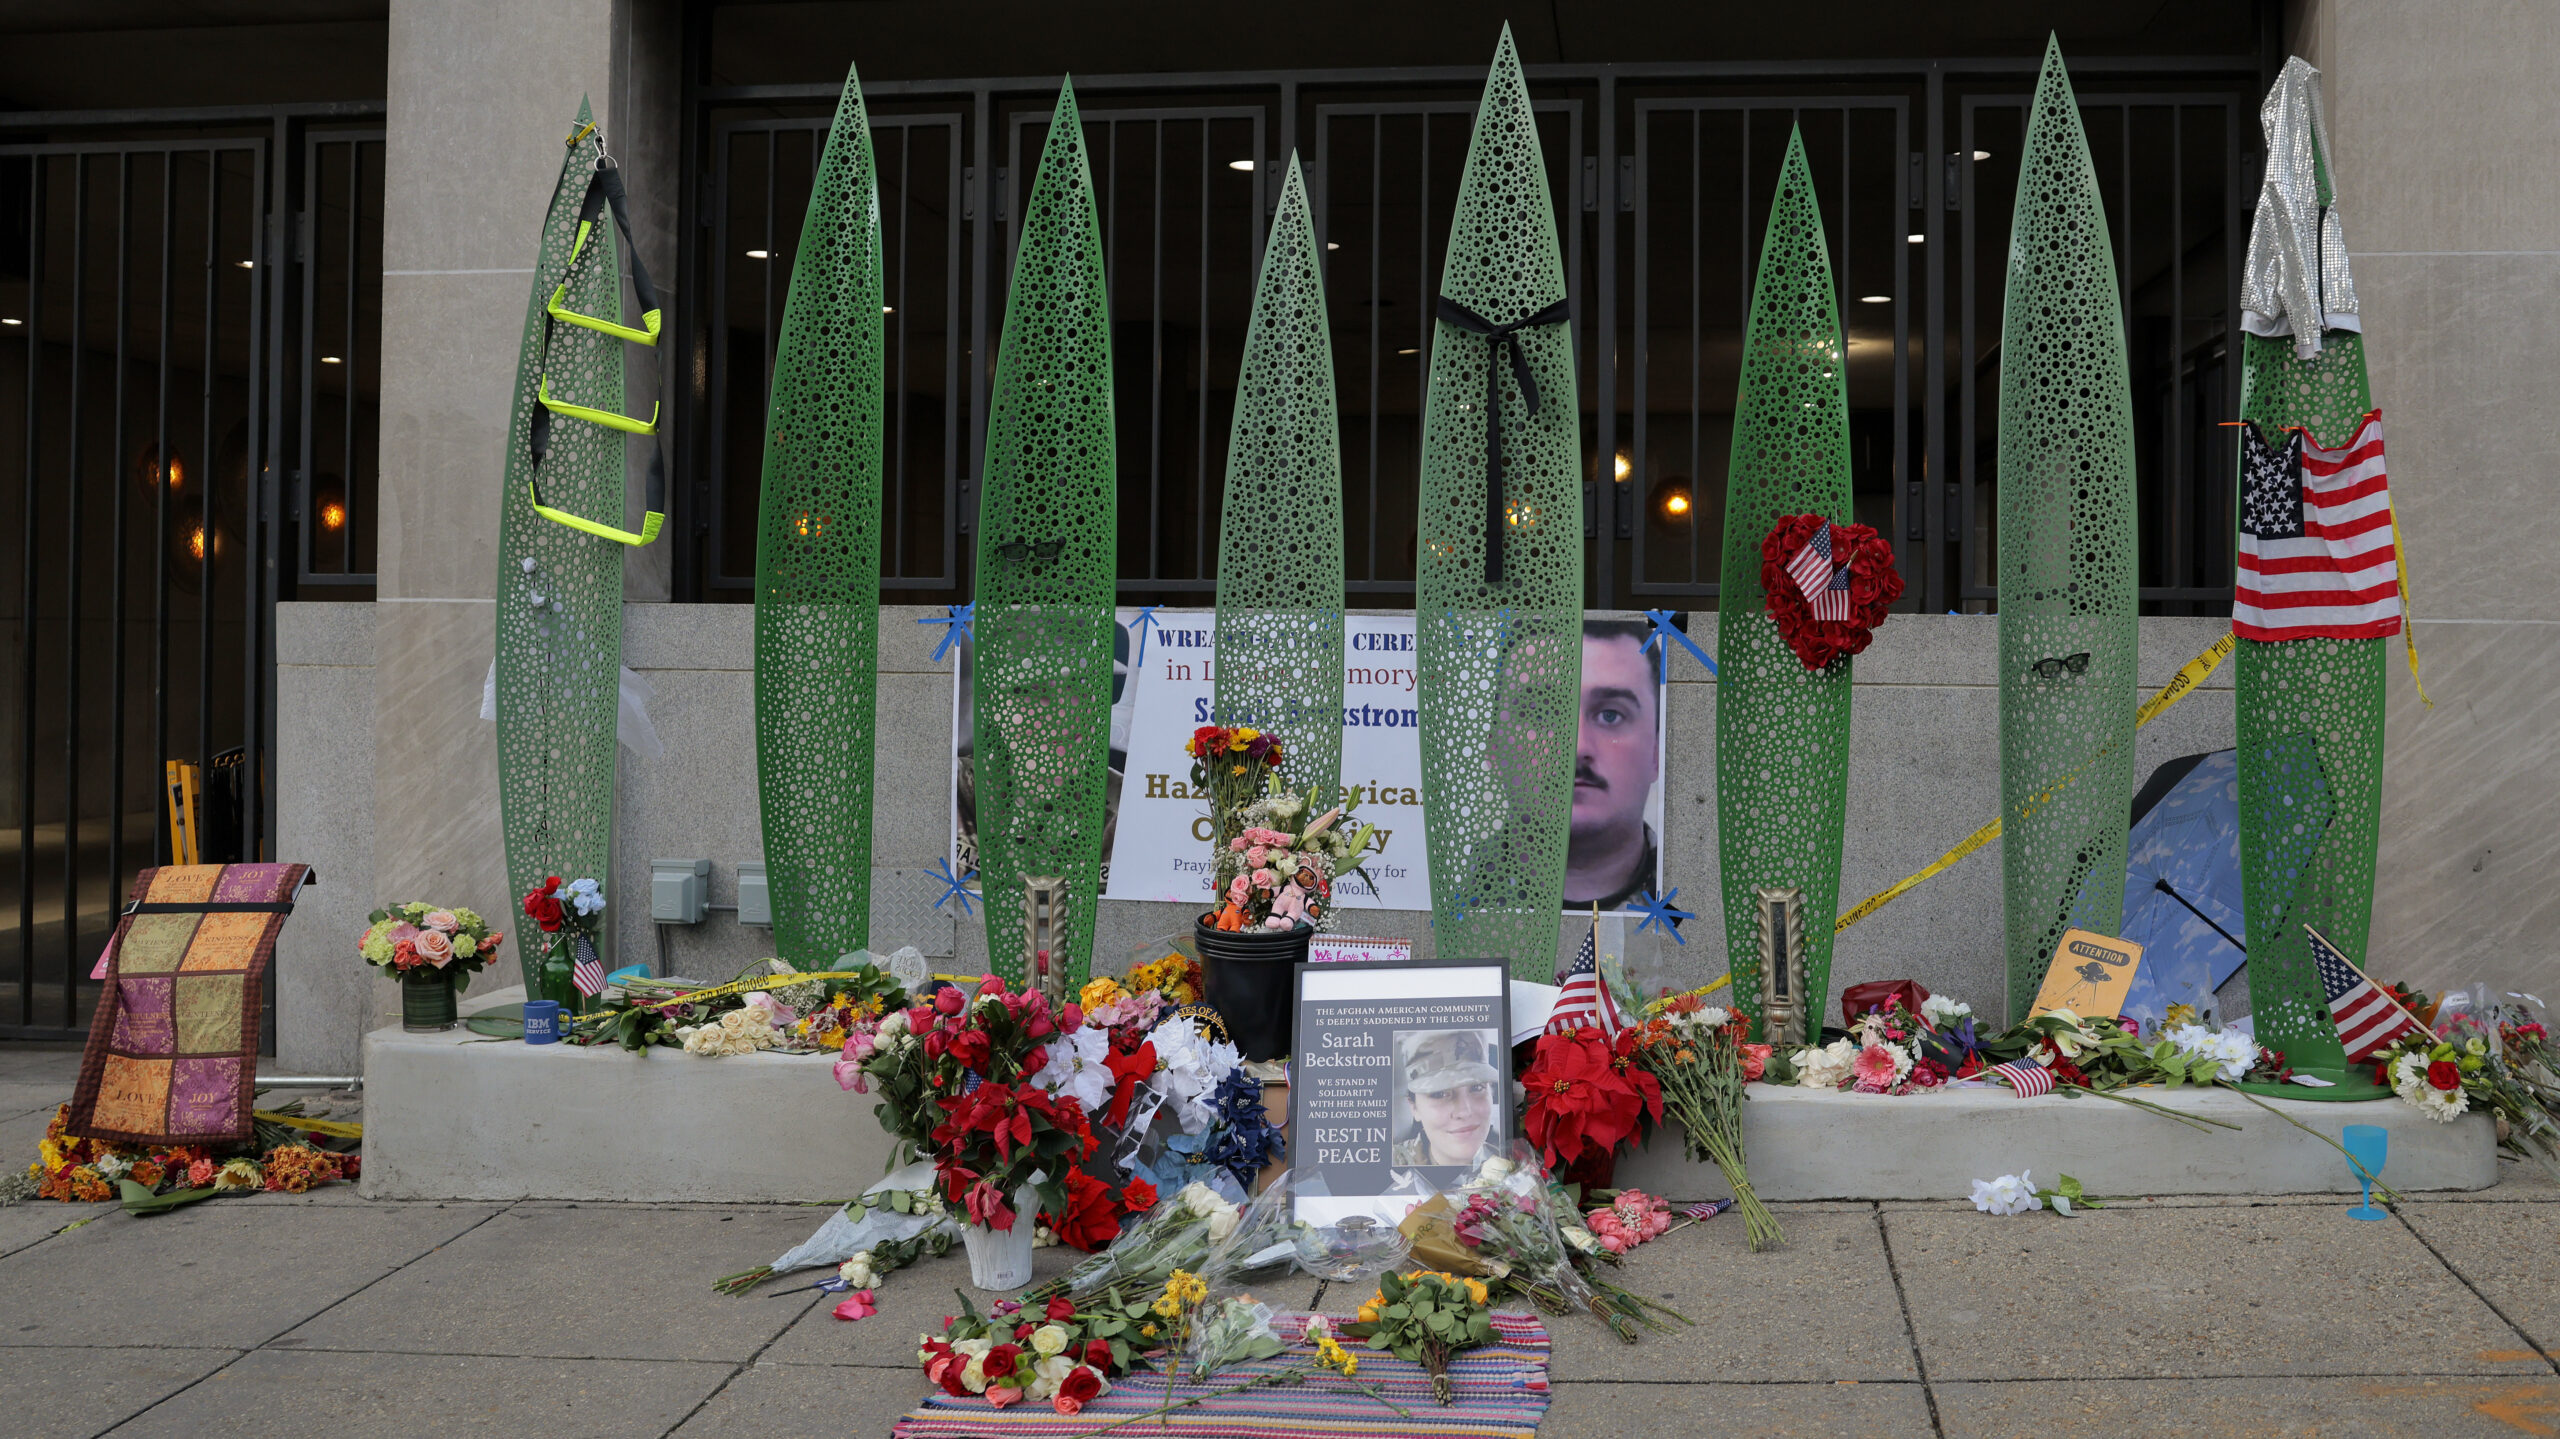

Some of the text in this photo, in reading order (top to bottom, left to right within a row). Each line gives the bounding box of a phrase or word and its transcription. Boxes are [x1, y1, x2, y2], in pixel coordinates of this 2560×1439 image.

[1353, 632, 1417, 651] CERE
[1166, 658, 1192, 681] in
[1346, 668, 1418, 692] mory
[1145, 773, 1208, 800] Haz
[1173, 858, 1213, 875] Prayi
[1385, 864, 1407, 878] for
[166, 874, 204, 883] LOVE
[239, 870, 268, 880] JOY
[1314, 949, 1333, 961] We
[1336, 950, 1359, 961] Love
[2072, 942, 2124, 964] ATTENTION
[1316, 1004, 1490, 1016] THE AFGHAN AMERICAN COMMUNITY
[527, 1018, 550, 1028] IBM
[1316, 1014, 1490, 1026] IS DEEPLY SADDENED BY THE LOSS OF
[1322, 1032, 1375, 1048] Sarah
[1305, 1052, 1392, 1068] Beckstrom
[1317, 1078, 1377, 1086] WE STAND IN
[116, 1090, 155, 1104] LOVE
[188, 1092, 217, 1104] JOY
[1318, 1089, 1374, 1097] SOLIDARITY
[1336, 1099, 1354, 1107] HER
[1356, 1099, 1388, 1108] FAMILY
[1308, 1110, 1387, 1119] AND LOVED ONES
[1314, 1127, 1387, 1143] REST IN
[1318, 1148, 1381, 1164] PEACE
